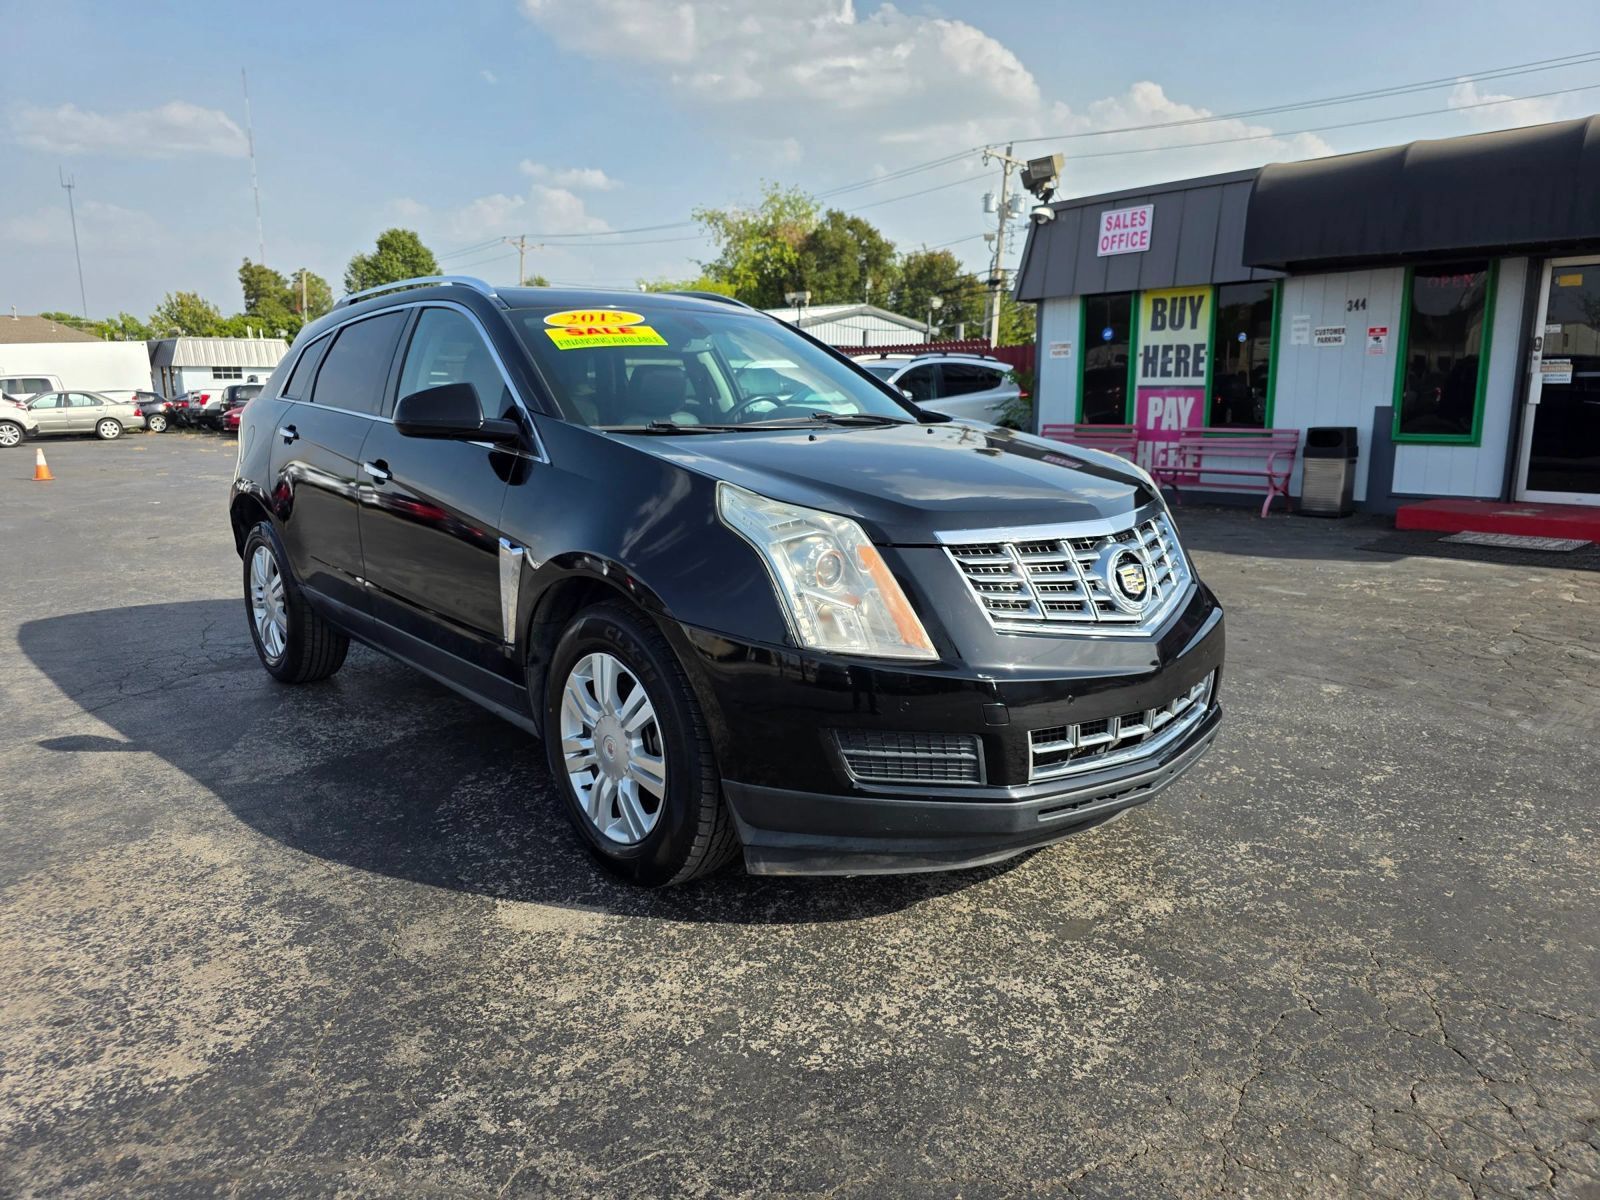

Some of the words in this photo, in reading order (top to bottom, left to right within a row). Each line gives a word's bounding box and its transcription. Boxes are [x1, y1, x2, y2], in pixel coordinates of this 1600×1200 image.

[1105, 210, 1147, 231] SALES
[1101, 230, 1148, 251] OFFICE
[1150, 295, 1205, 332] BUY
[1347, 298, 1366, 312] 344
[567, 313, 624, 324] 2015
[565, 327, 636, 336] SALE
[1314, 328, 1345, 336] CUSTOMER
[1317, 336, 1342, 344] PARKING
[1142, 343, 1206, 378] HERE
[1146, 396, 1195, 432] PAY
[1136, 440, 1200, 476] HERE
